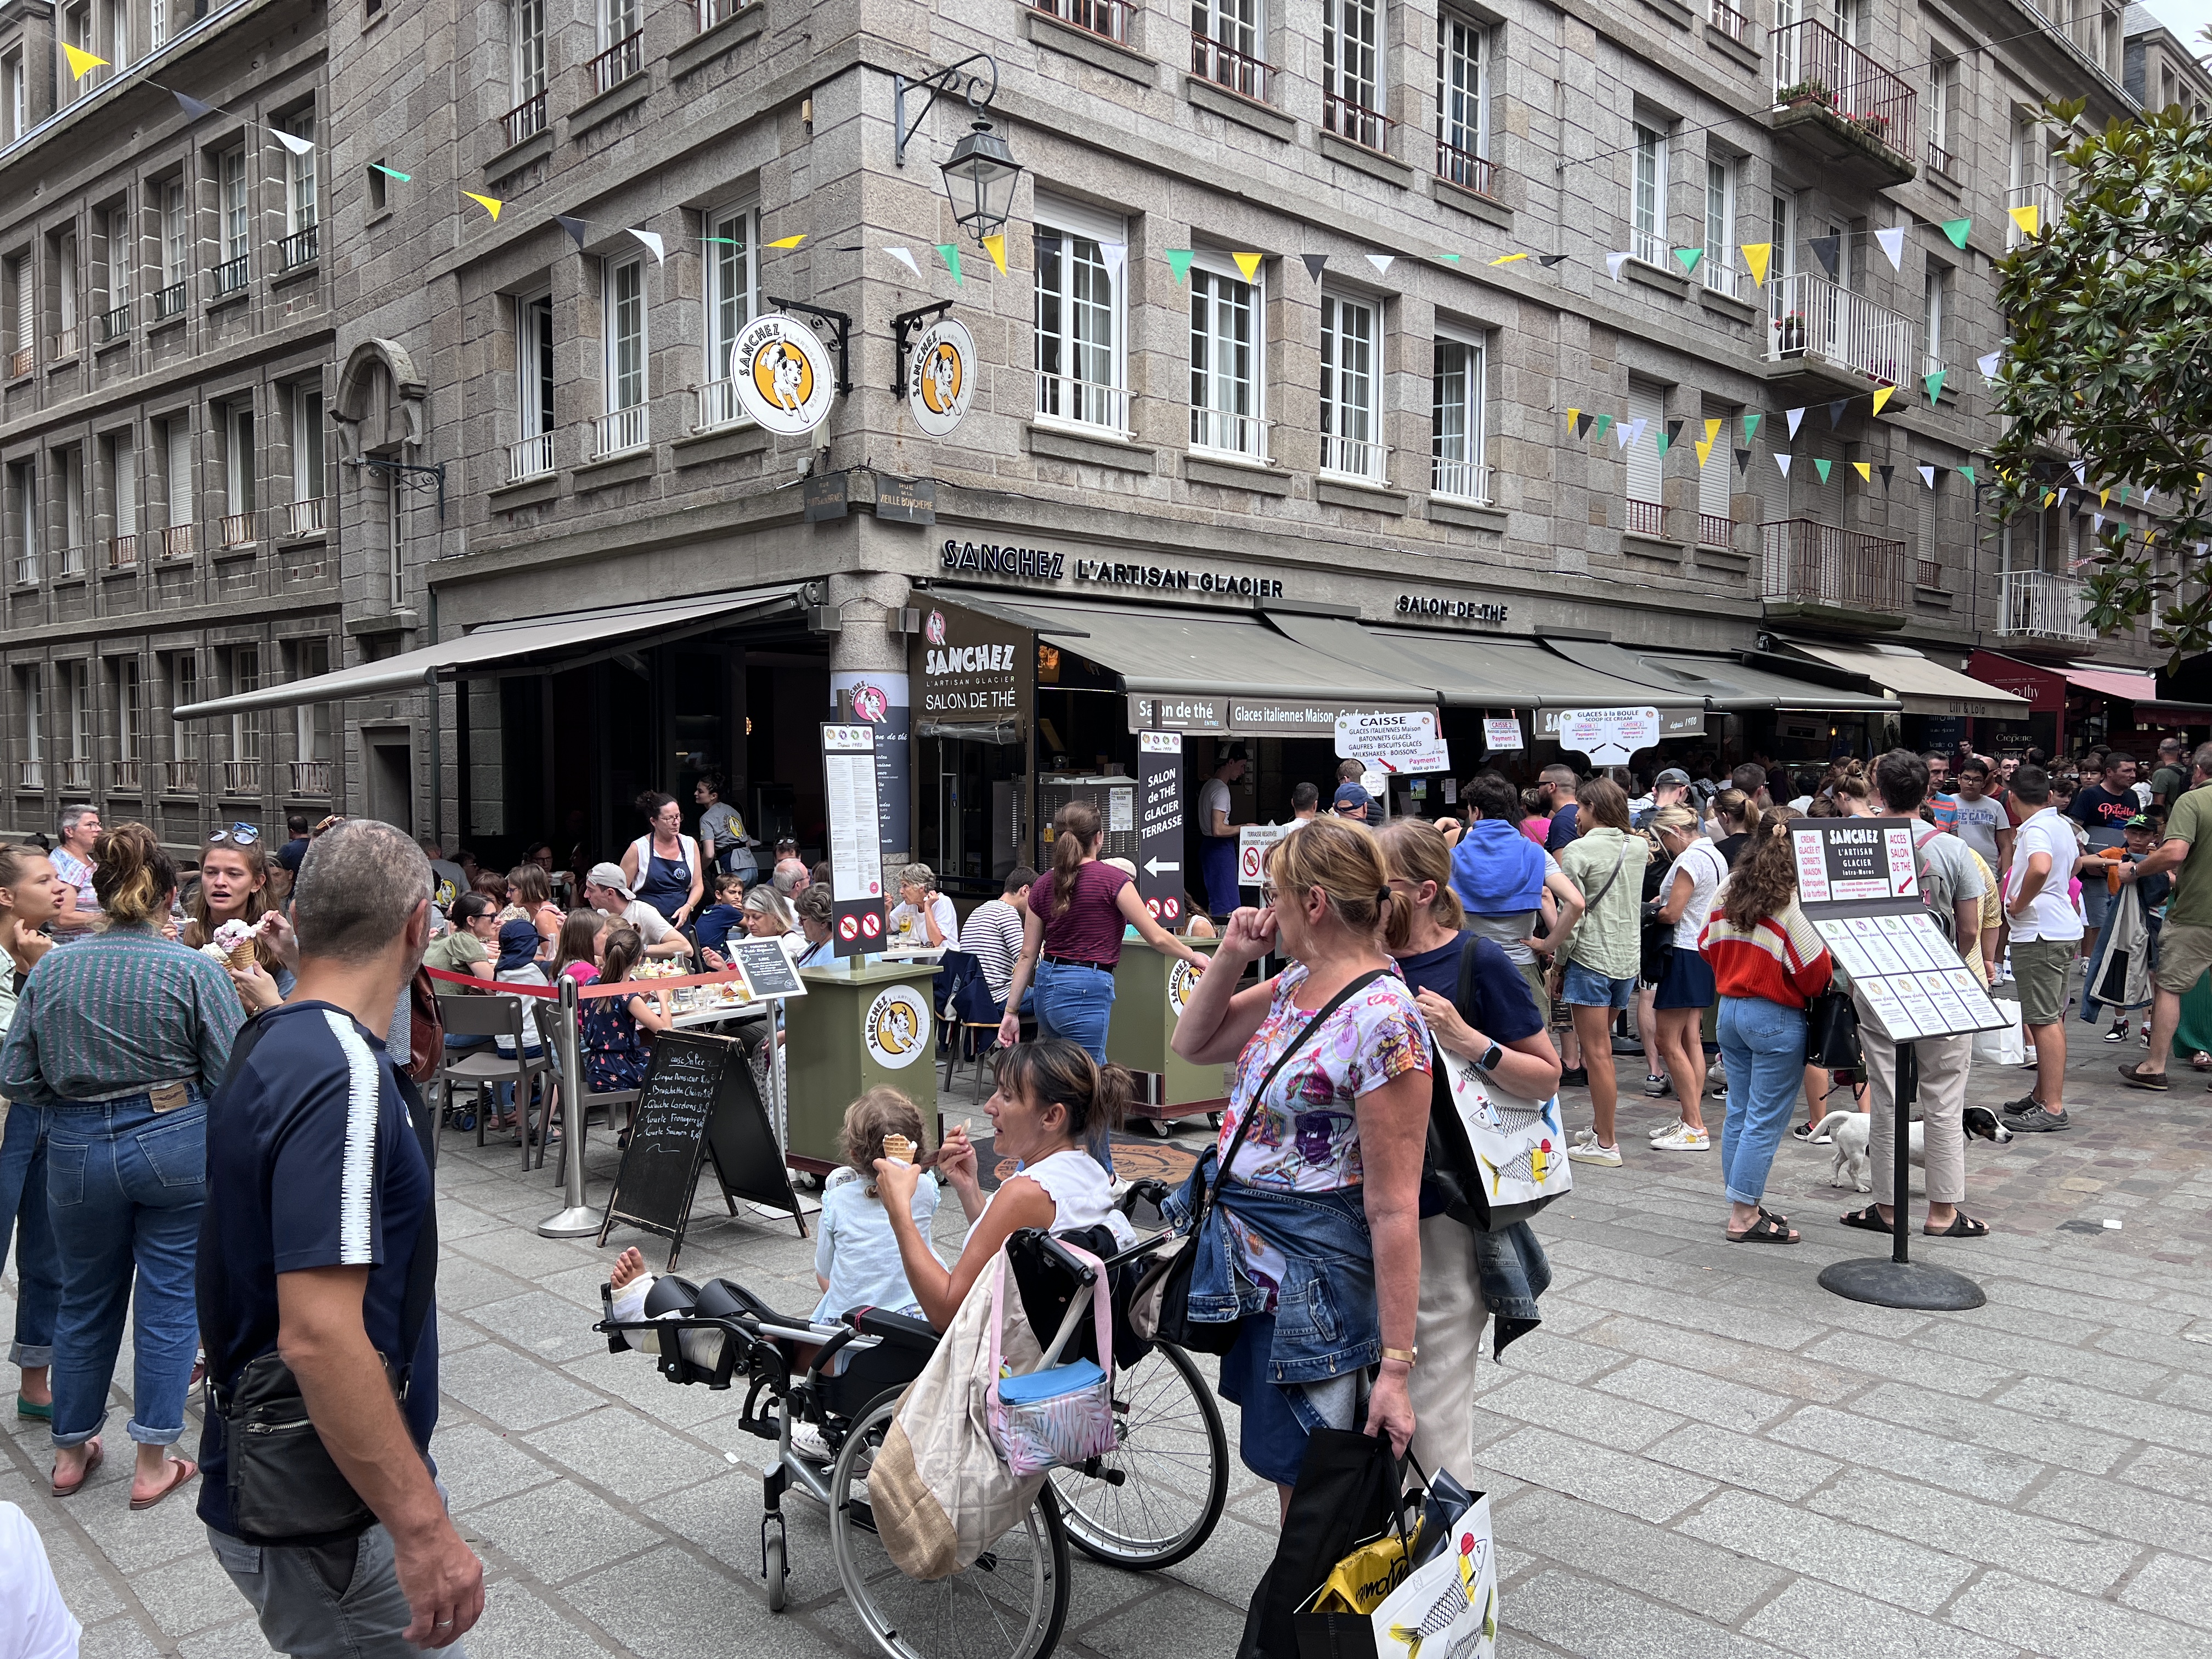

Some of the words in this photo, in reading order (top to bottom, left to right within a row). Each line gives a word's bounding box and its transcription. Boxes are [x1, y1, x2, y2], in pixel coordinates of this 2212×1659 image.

[740, 324, 780, 376] SANCHEZ
[790, 333, 819, 369] L'ARTISAN
[809, 373, 821, 408] GLACIER
[913, 330, 937, 397] SANCHEZ
[879, 494, 900, 506] VIEILLE
[901, 497, 933, 510] BOUCHERIE
[943, 540, 1065, 579] SANCHEZ
[1075, 558, 1189, 589] L'ARTISAN
[1197, 571, 1283, 598] GLACIER
[1397, 595, 1449, 616] SALON
[1455, 601, 1475, 618] DE
[1481, 603, 1508, 621] THE
[926, 644, 1015, 676] SANCHEZ
[926, 678, 970, 687] L'ARTISAN
[975, 675, 1015, 685] GLACIER
[926, 692, 967, 710] SALON
[970, 692, 987, 708] DE
[991, 687, 1015, 707] THÉ
[1139, 701, 1173, 718] Saon
[1176, 701, 1190, 718] de
[1194, 703, 1213, 719] thé
[1235, 706, 1262, 721] Glaces
[1264, 707, 1304, 723] italiennes
[1305, 708, 1334, 723] Maison
[1949, 701, 1961, 713] Lili
[1963, 702, 1968, 713] &
[1971, 703, 1985, 714] Lola
[1360, 716, 1406, 726] CAISSE
[1670, 721, 1684, 730] depuis
[1685, 716, 1697, 726] 1980
[1148, 768, 1176, 787] SALON
[1148, 792, 1158, 804] de
[1159, 782, 1176, 799] THÉ
[1144, 800, 1179, 821] GLACIER
[1969, 812, 1994, 822] CAMP
[2135, 814, 2148, 823] NY
[1141, 814, 1182, 839] TERRASSE
[1801, 834, 1816, 843] CRÈME
[1830, 828, 1878, 845] SANCHEZ
[1890, 832, 1906, 844] ACCÈS
[1799, 844, 1815, 854] GLACÉE
[1838, 848, 1873, 856] L'ARTISAN
[1891, 848, 1909, 857] SALON
[1892, 862, 1899, 871] DE
[1900, 860, 1911, 871] THÉ
[1802, 878, 1825, 888] Fabriquées
[1803, 889, 1806, 898] à
[1807, 889, 1811, 898] la
[1812, 889, 1827, 897] turbine
[1171, 960, 1187, 1003] SANCHEZ
[868, 995, 888, 1049] SANCHEZ
[647, 1099, 669, 1109] Quiche
[670, 1098, 696, 1111] Lardons
